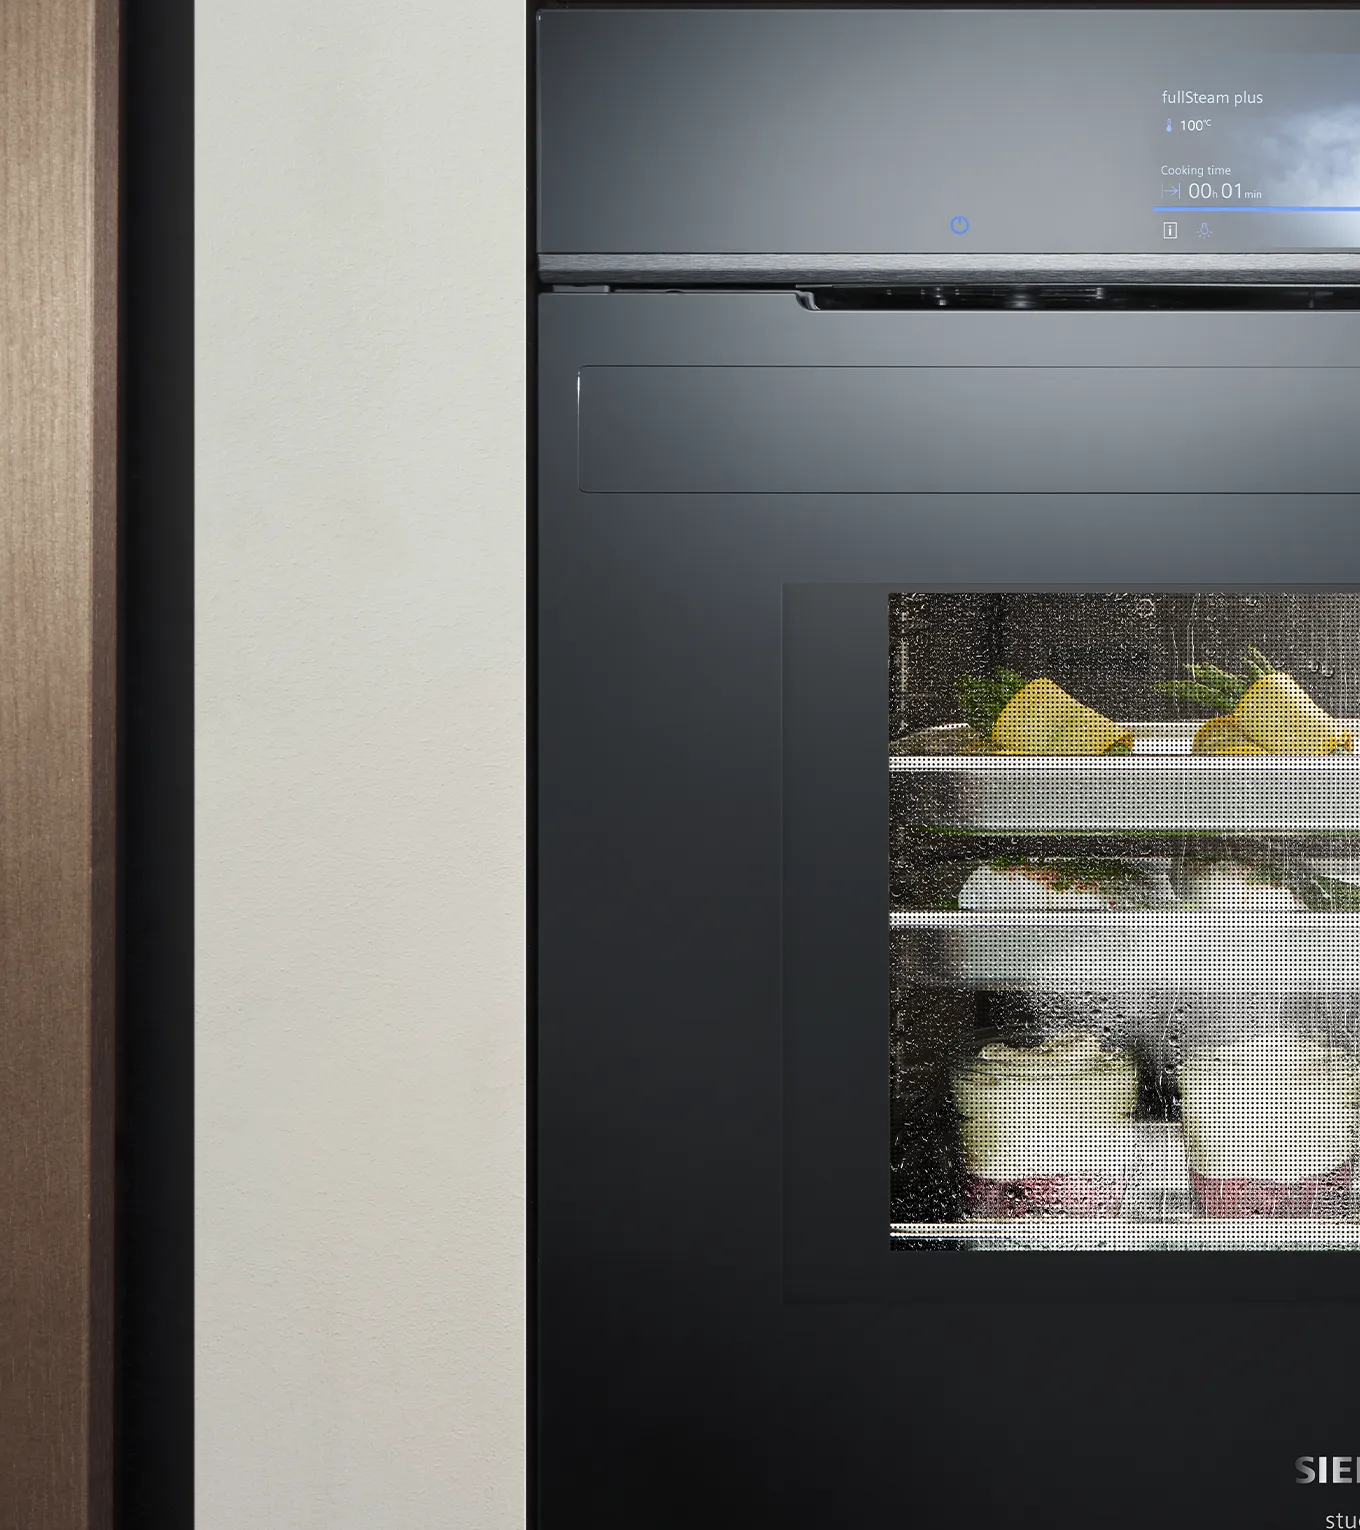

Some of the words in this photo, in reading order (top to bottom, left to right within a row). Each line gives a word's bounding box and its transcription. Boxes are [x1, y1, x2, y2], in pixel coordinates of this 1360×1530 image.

[1161, 90, 1229, 104] fullSteam
[1234, 90, 1264, 107] plus
[1161, 165, 1204, 178] Cooking
[1207, 165, 1232, 176] time
